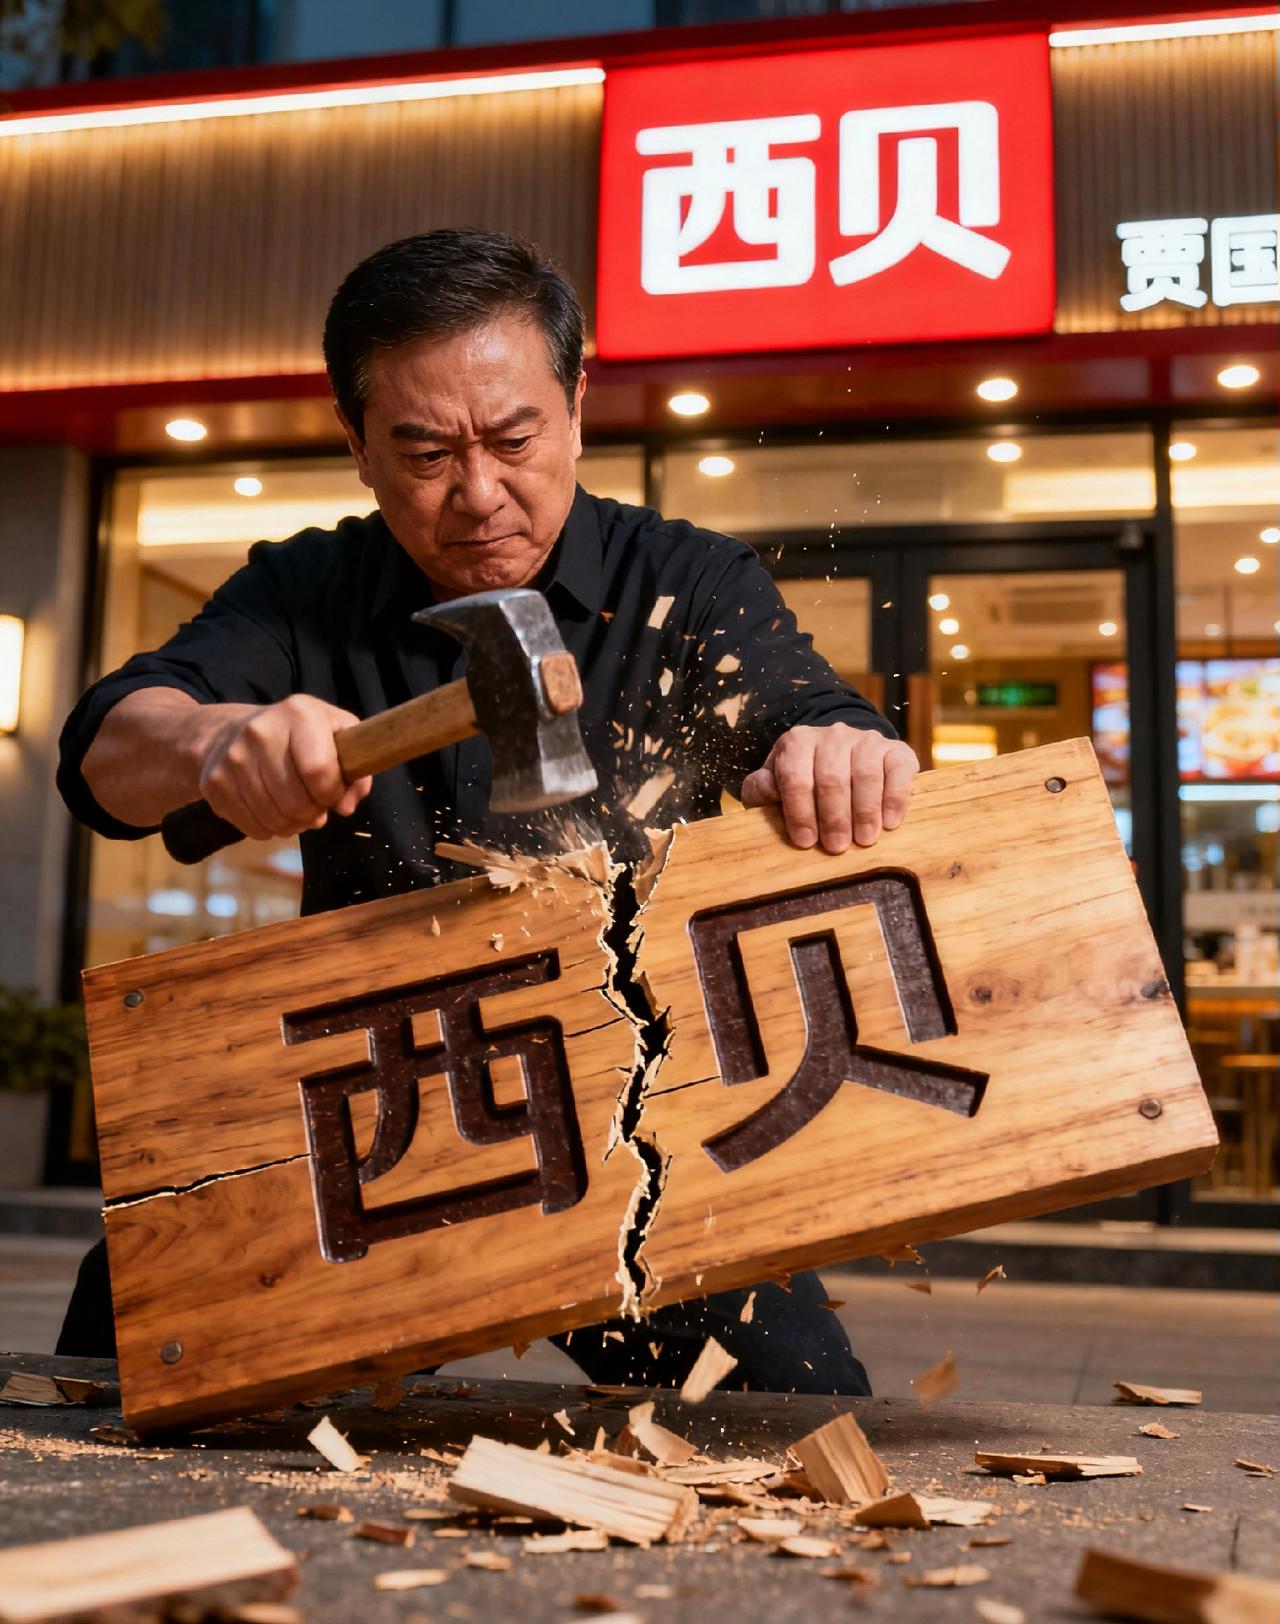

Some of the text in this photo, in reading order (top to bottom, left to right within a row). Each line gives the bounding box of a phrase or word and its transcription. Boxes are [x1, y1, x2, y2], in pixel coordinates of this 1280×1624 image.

[635, 100, 1012, 295] 西贝
[1116, 213, 1280, 312] 贾国
[281, 866, 990, 1264] 西贝
